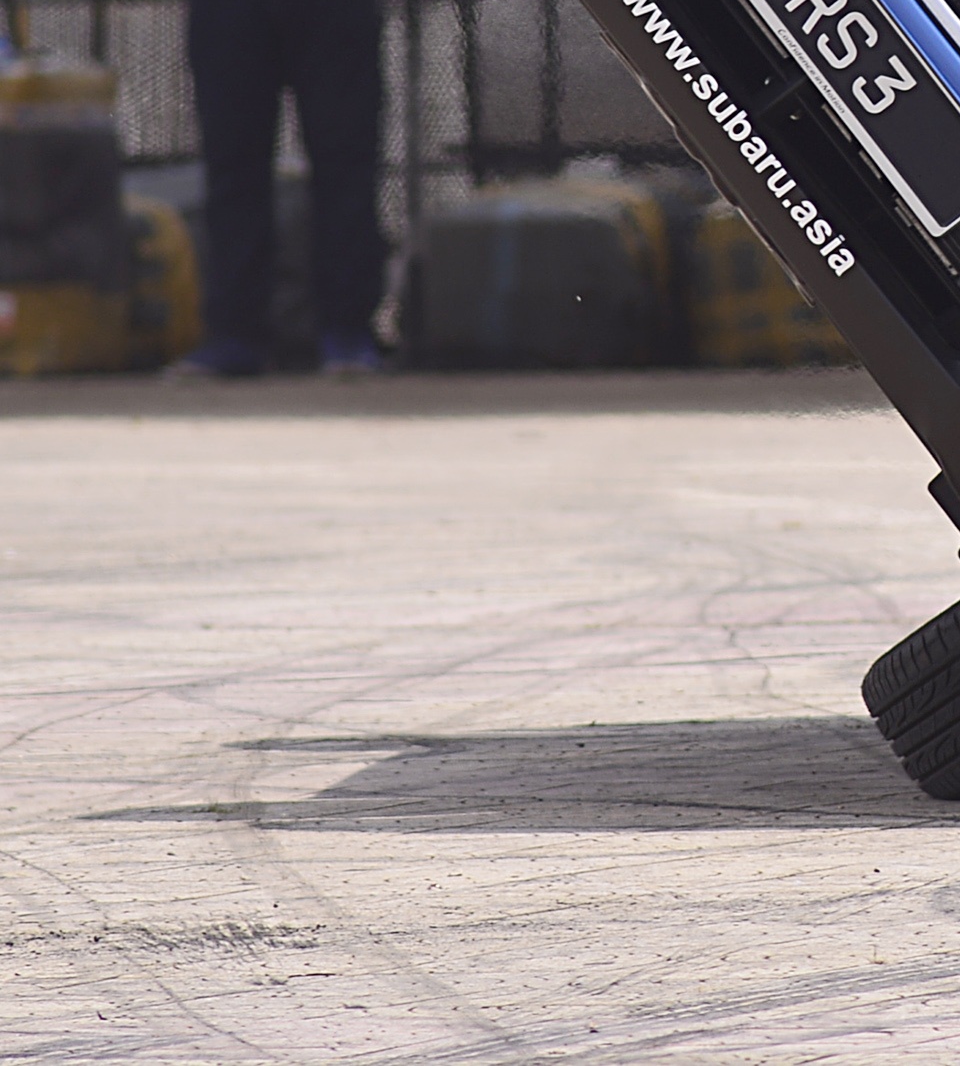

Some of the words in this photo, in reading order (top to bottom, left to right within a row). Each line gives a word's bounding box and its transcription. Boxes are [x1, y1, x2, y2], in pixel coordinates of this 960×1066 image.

[778, 28, 815, 75] Confidence
[820, 83, 846, 114] Motion
[852, 55, 917, 114] 3
